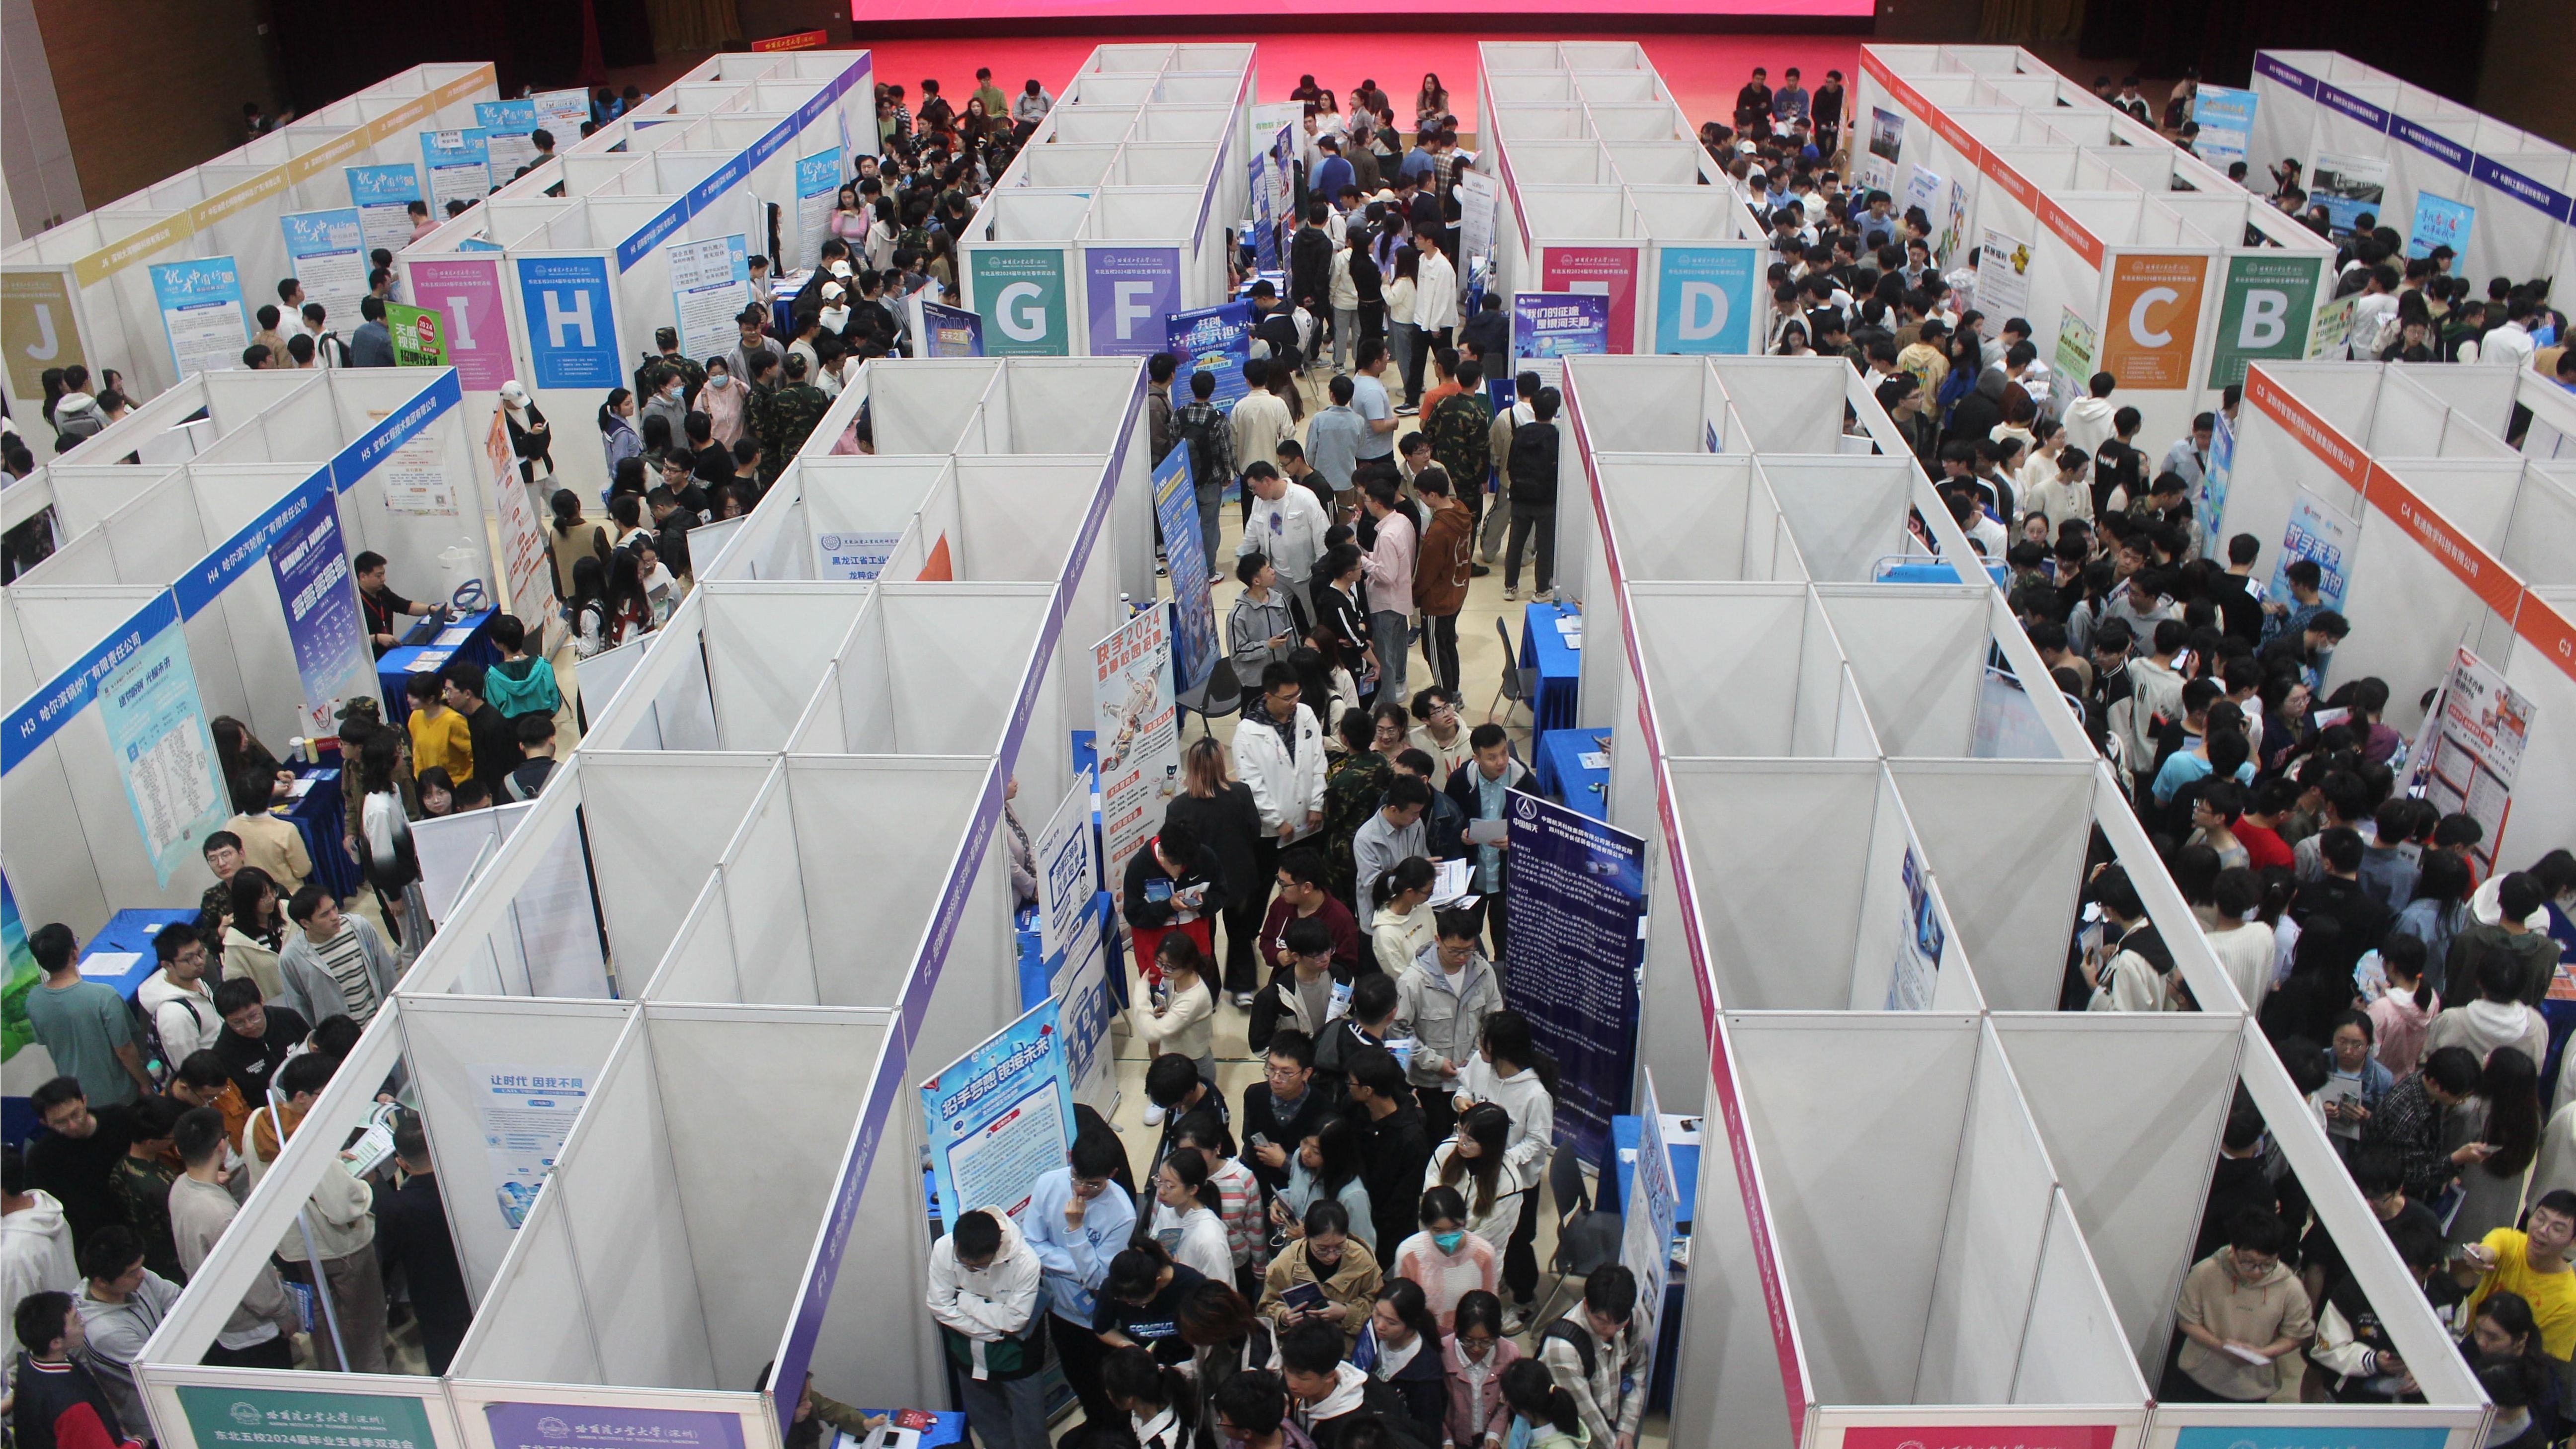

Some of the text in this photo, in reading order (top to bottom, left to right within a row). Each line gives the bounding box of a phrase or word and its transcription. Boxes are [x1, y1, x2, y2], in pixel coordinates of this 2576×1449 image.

[543, 290, 597, 348] H
[996, 281, 1047, 342] G
[1114, 281, 1154, 340] F
[1526, 306, 1580, 320] 我们的征途
[1679, 281, 1729, 340] D
[2129, 286, 2179, 348] C
[2238, 289, 2288, 348] B
[26, 304, 59, 360] J
[419, 320, 433, 330] 2024
[447, 297, 477, 349] I
[1198, 316, 1221, 331] 共创
[1185, 325, 1235, 347] 共享共担
[360, 447, 372, 463] H5
[2401, 502, 2412, 519] C4
[832, 556, 889, 565] 黑龙江省工业
[207, 566, 221, 585] H4
[1097, 609, 1160, 665] 快手2024
[2559, 638, 2572, 657] C3
[21, 632, 142, 739] H3 哈尔滨锅炉厂有限责任公司
[1513, 817, 1538, 833] 中国航天
[923, 965, 932, 985] F2
[491, 1075, 582, 1088] 让时代 因我不同
[942, 1069, 997, 1119] 招手梦想
[215, 1431, 414, 1449] 东北五校2024届毕业生春季双选会
